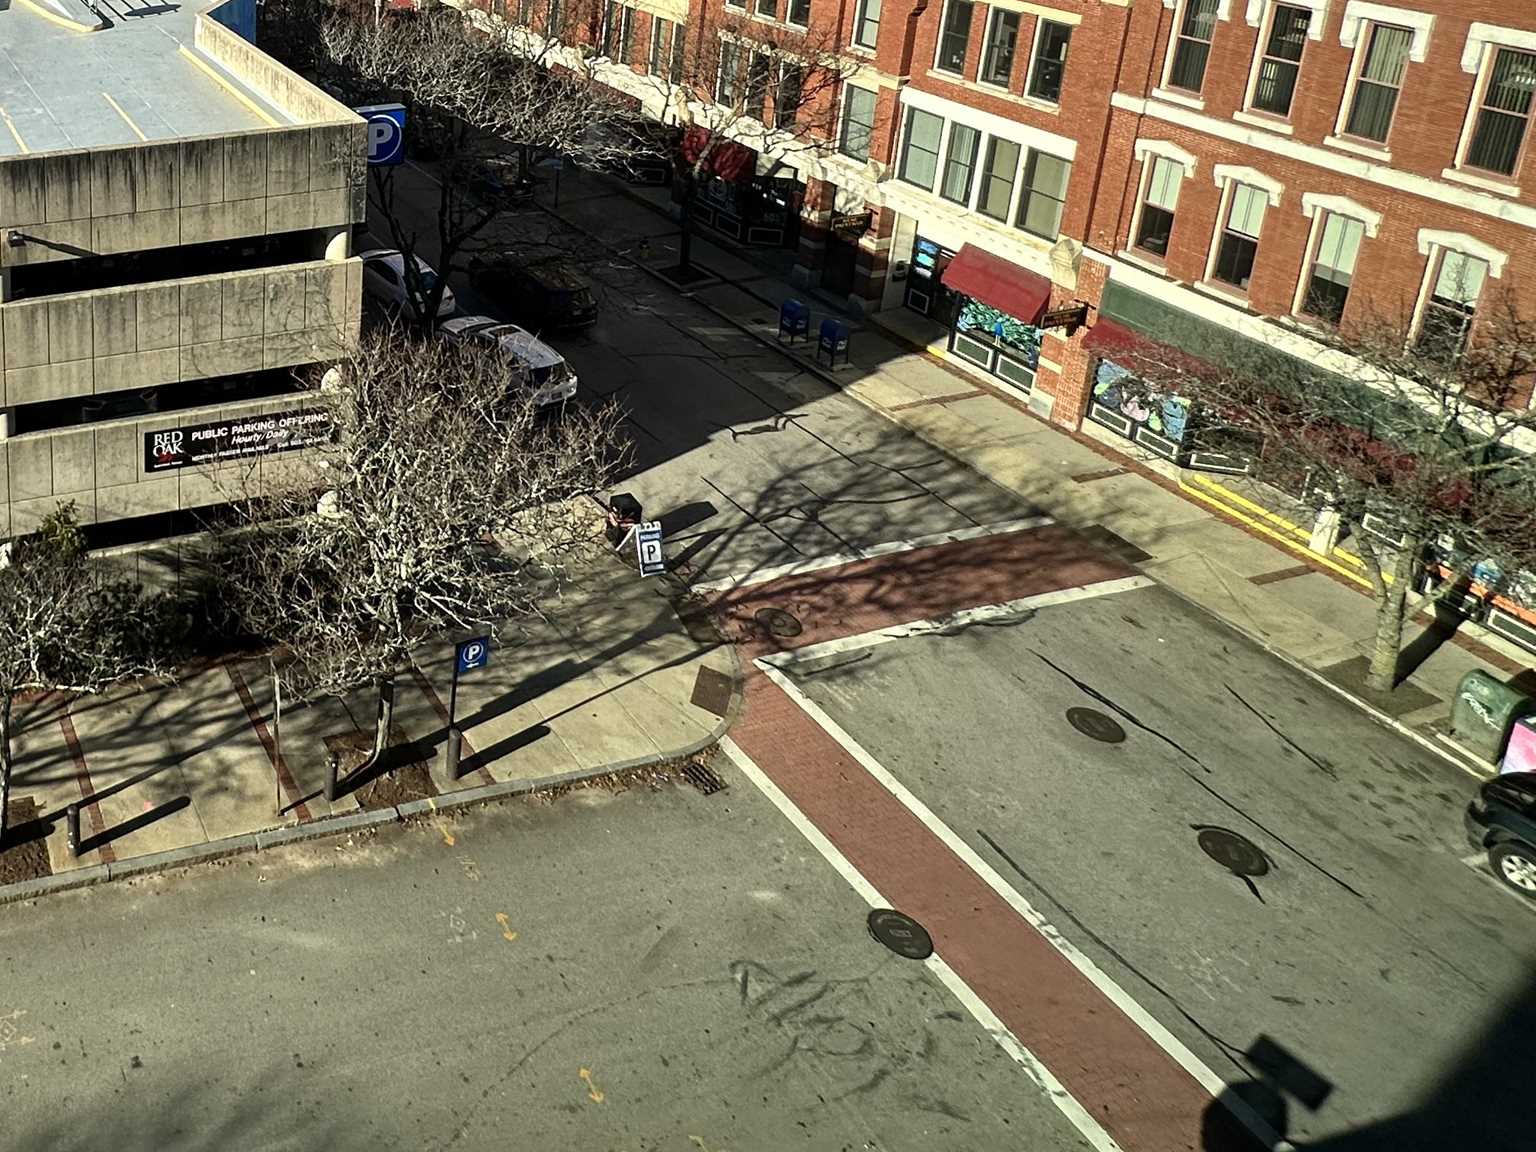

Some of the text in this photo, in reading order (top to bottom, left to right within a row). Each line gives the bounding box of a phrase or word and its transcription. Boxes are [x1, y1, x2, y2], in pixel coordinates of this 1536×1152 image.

[367, 122, 394, 156] P
[191, 412, 329, 441] PUBLIC PARKING OFFERING
[154, 430, 184, 447] RED
[231, 428, 289, 445] Hourly/Daily
[152, 442, 184, 458] OAK
[647, 544, 656, 561] P
[468, 645, 480, 660] P
